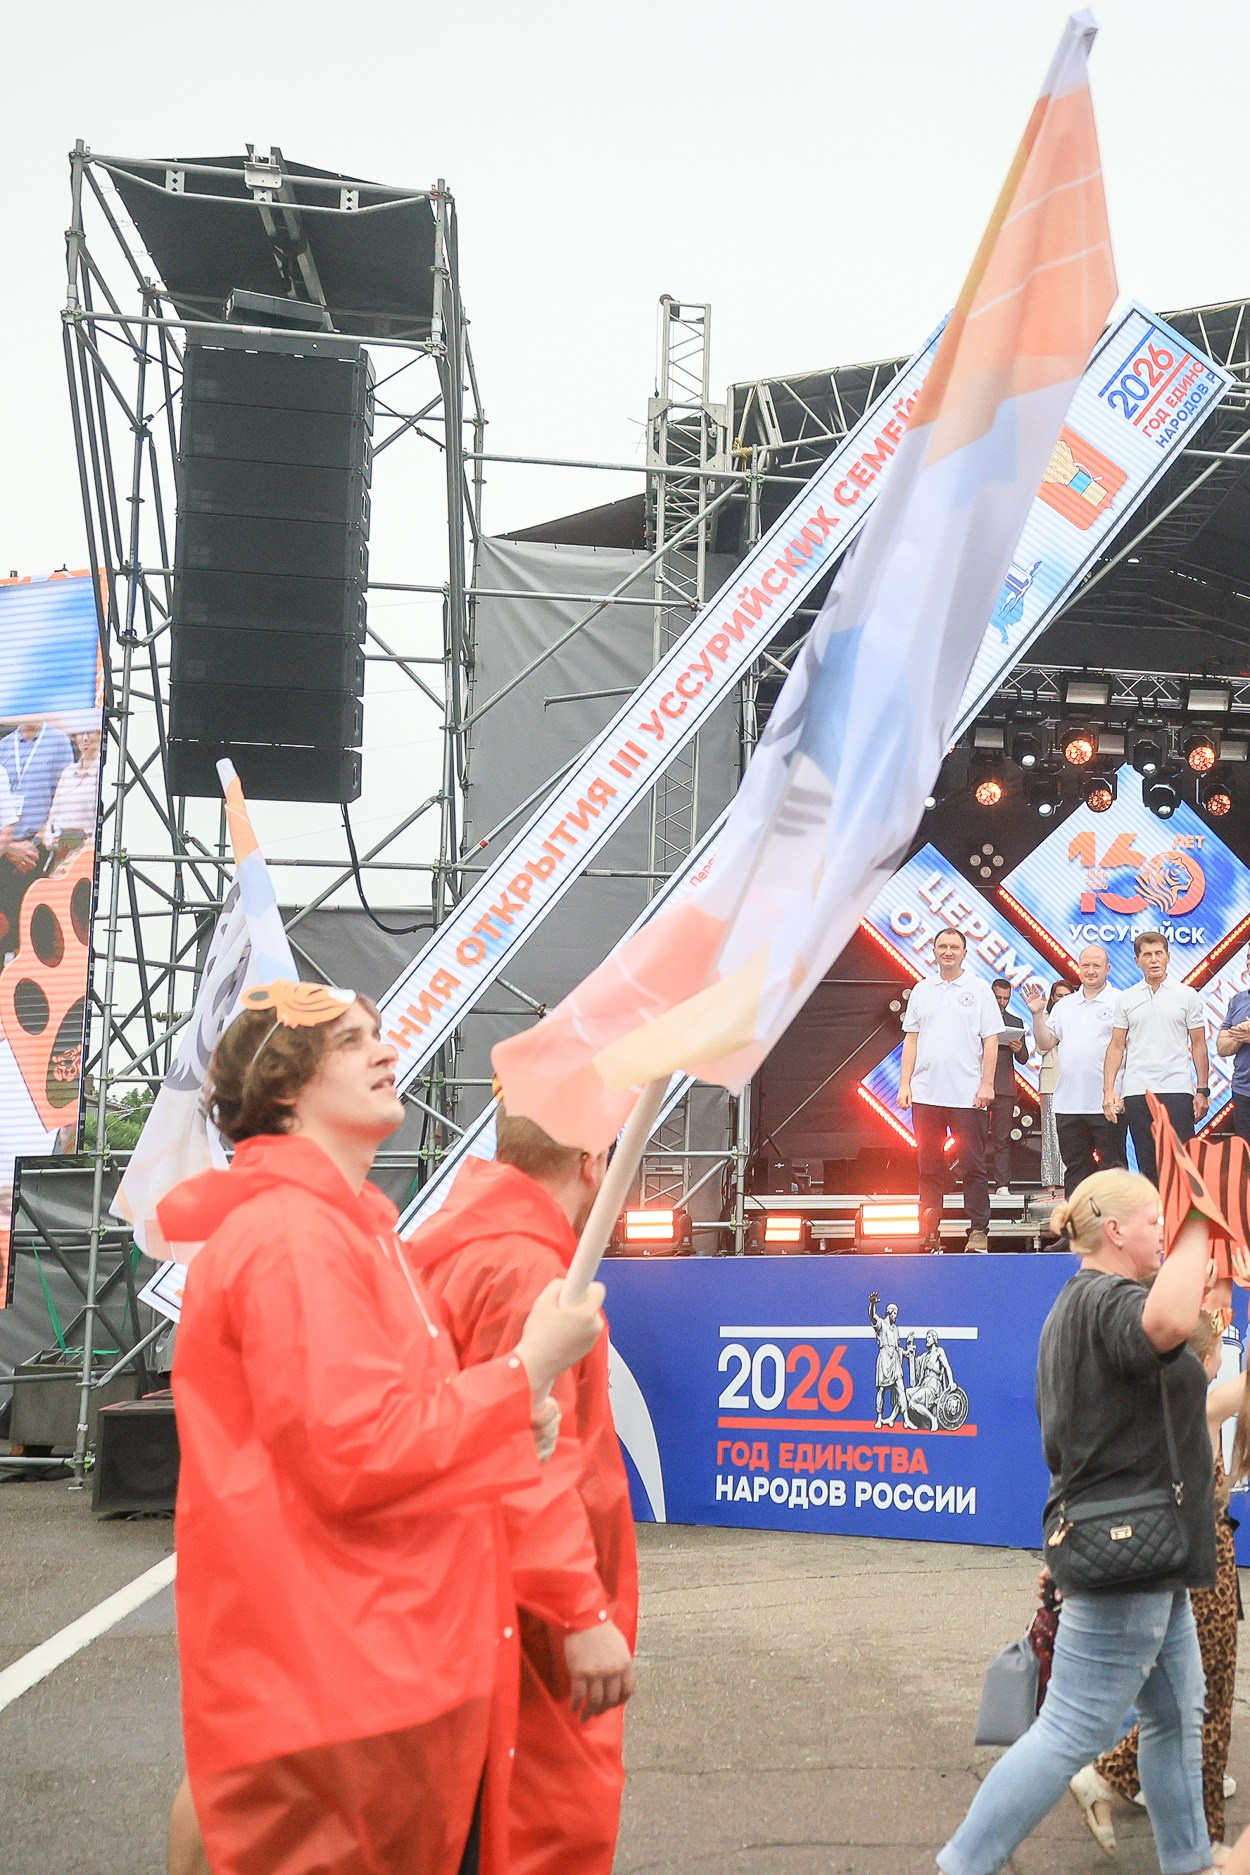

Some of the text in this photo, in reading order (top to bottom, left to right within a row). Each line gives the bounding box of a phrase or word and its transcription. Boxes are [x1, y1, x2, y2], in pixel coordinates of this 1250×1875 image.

[1107, 342, 1174, 420] 2026
[1142, 361, 1205, 438] ГОД ЕДИНС
[1155, 383, 1209, 448] НАРОДОВ
[456, 777, 618, 967] ОТКРЫТИЯ
[609, 740, 648, 779] III
[638, 505, 840, 741] УССУРИЙСКИХ
[1172, 834, 1206, 849] ЛЕТ
[717, 1343, 854, 1412] 2026
[716, 1440, 928, 1475] ГОД ЕДИНСТВА
[715, 1474, 976, 1515] НАРОДОВ РОССИИ
